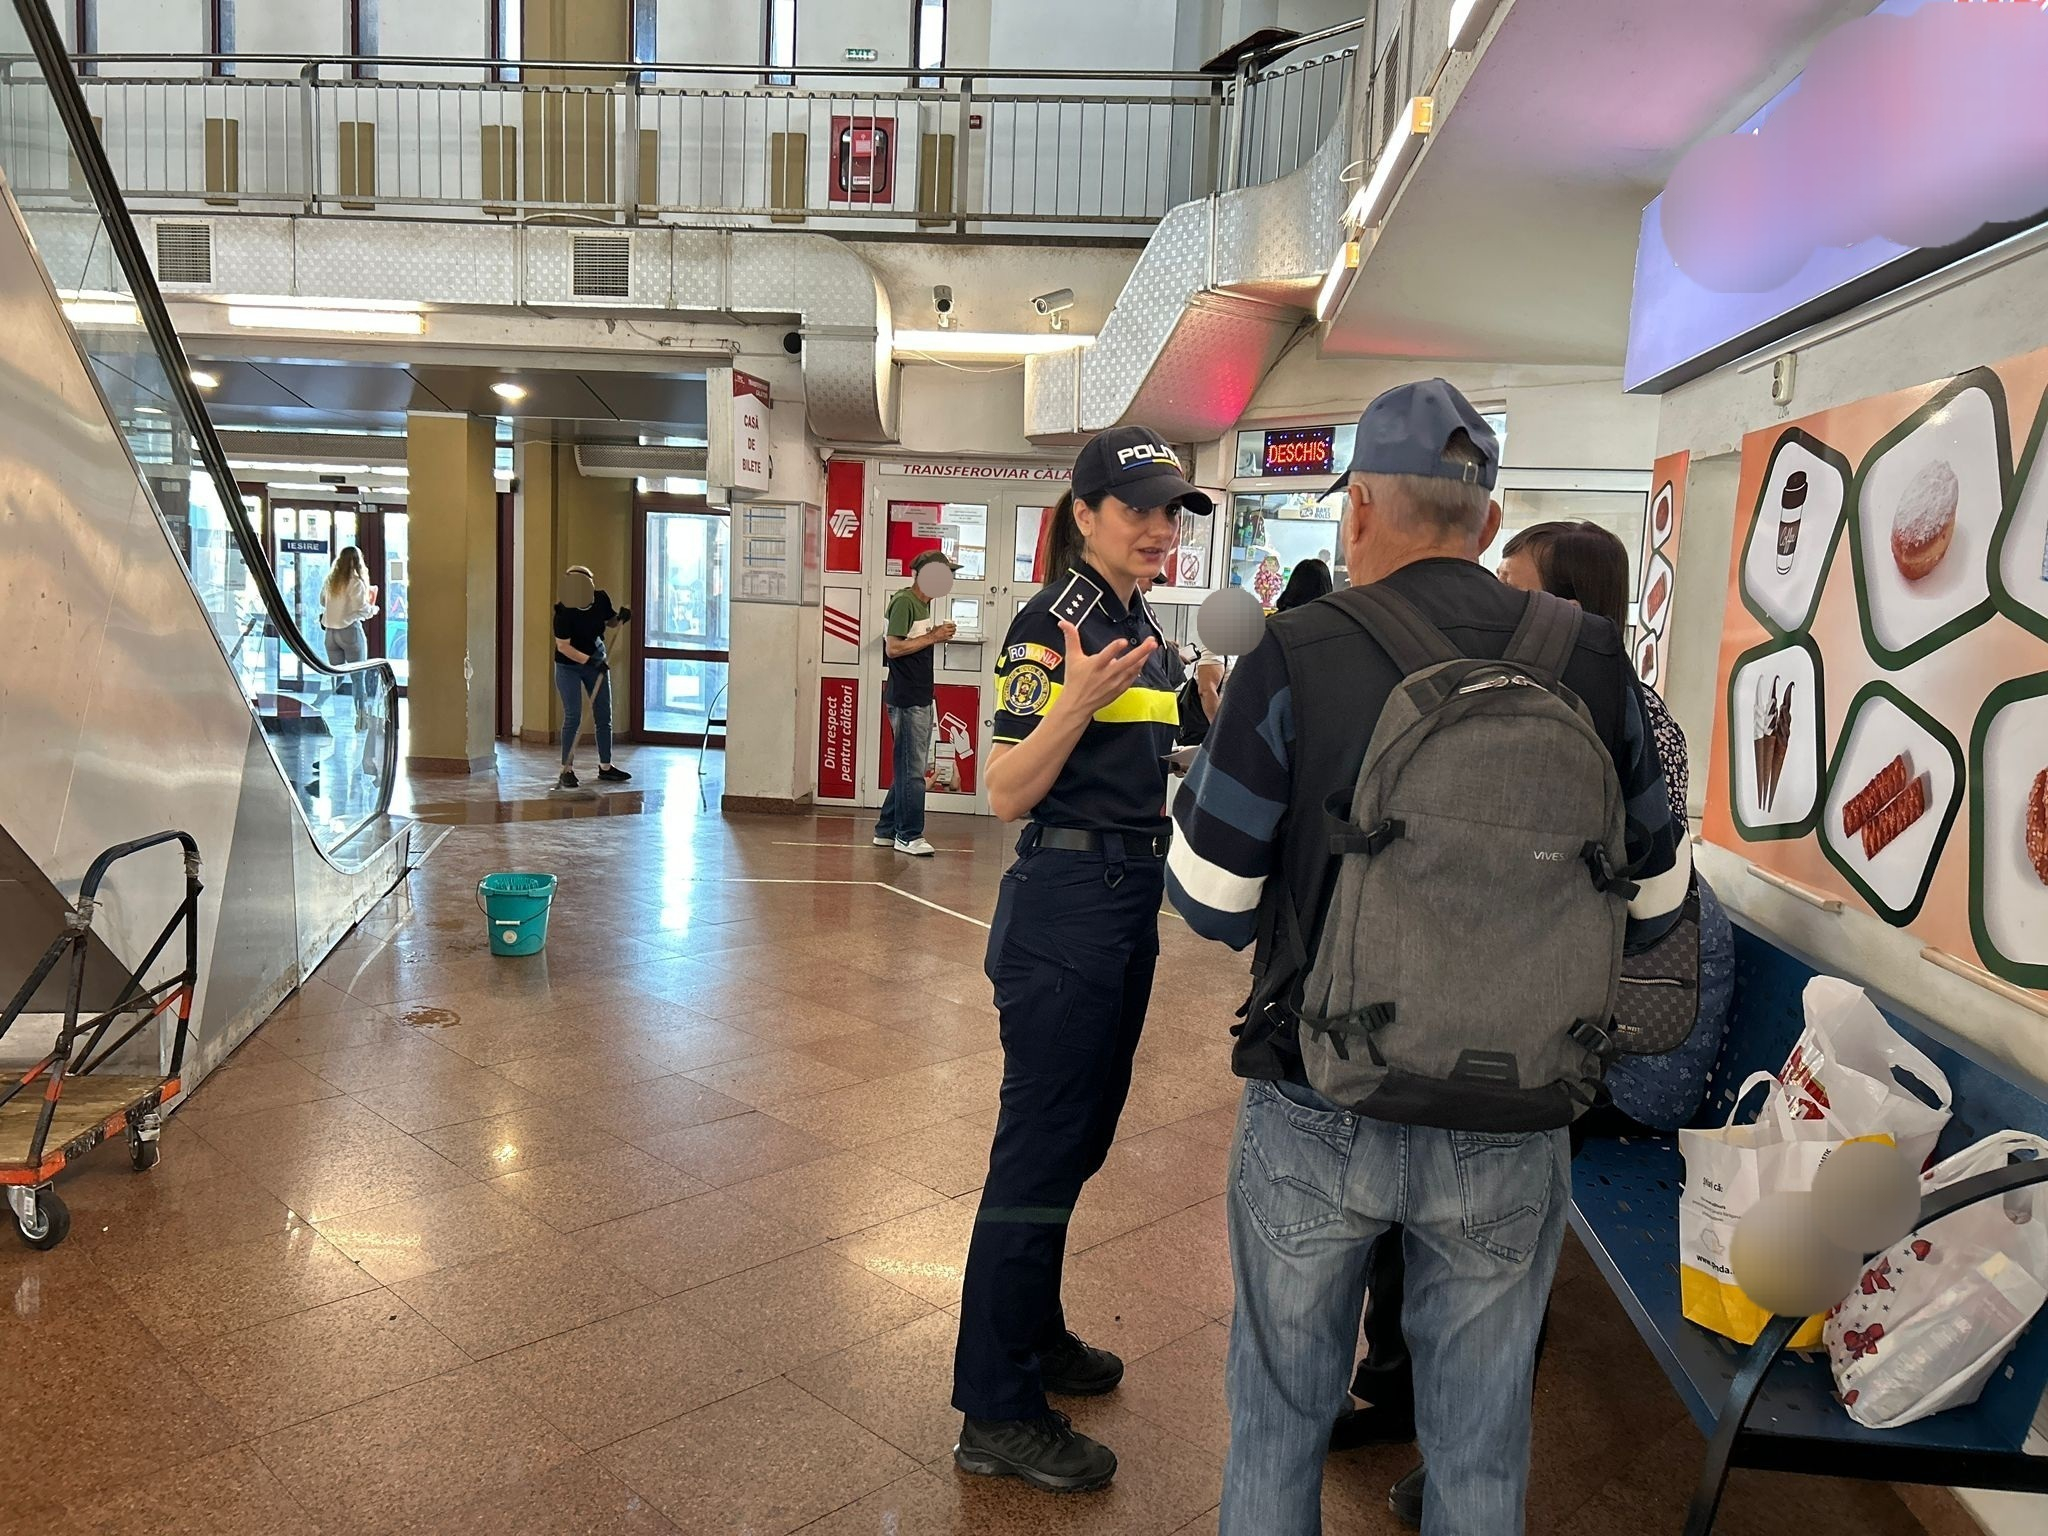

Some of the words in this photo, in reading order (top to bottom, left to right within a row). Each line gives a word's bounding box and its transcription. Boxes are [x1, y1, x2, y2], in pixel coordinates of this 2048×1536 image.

[747, 437, 756, 451] DE
[1268, 441, 1326, 464] DESCHIS
[742, 458, 761, 474] BILETE
[903, 464, 1029, 479] TRANSFEROVIAR
[1033, 467, 1073, 480] CĂLĂ
[840, 685, 853, 735] călători
[826, 696, 839, 744] respect
[824, 754, 836, 769] Din
[840, 738, 853, 782] pentru
